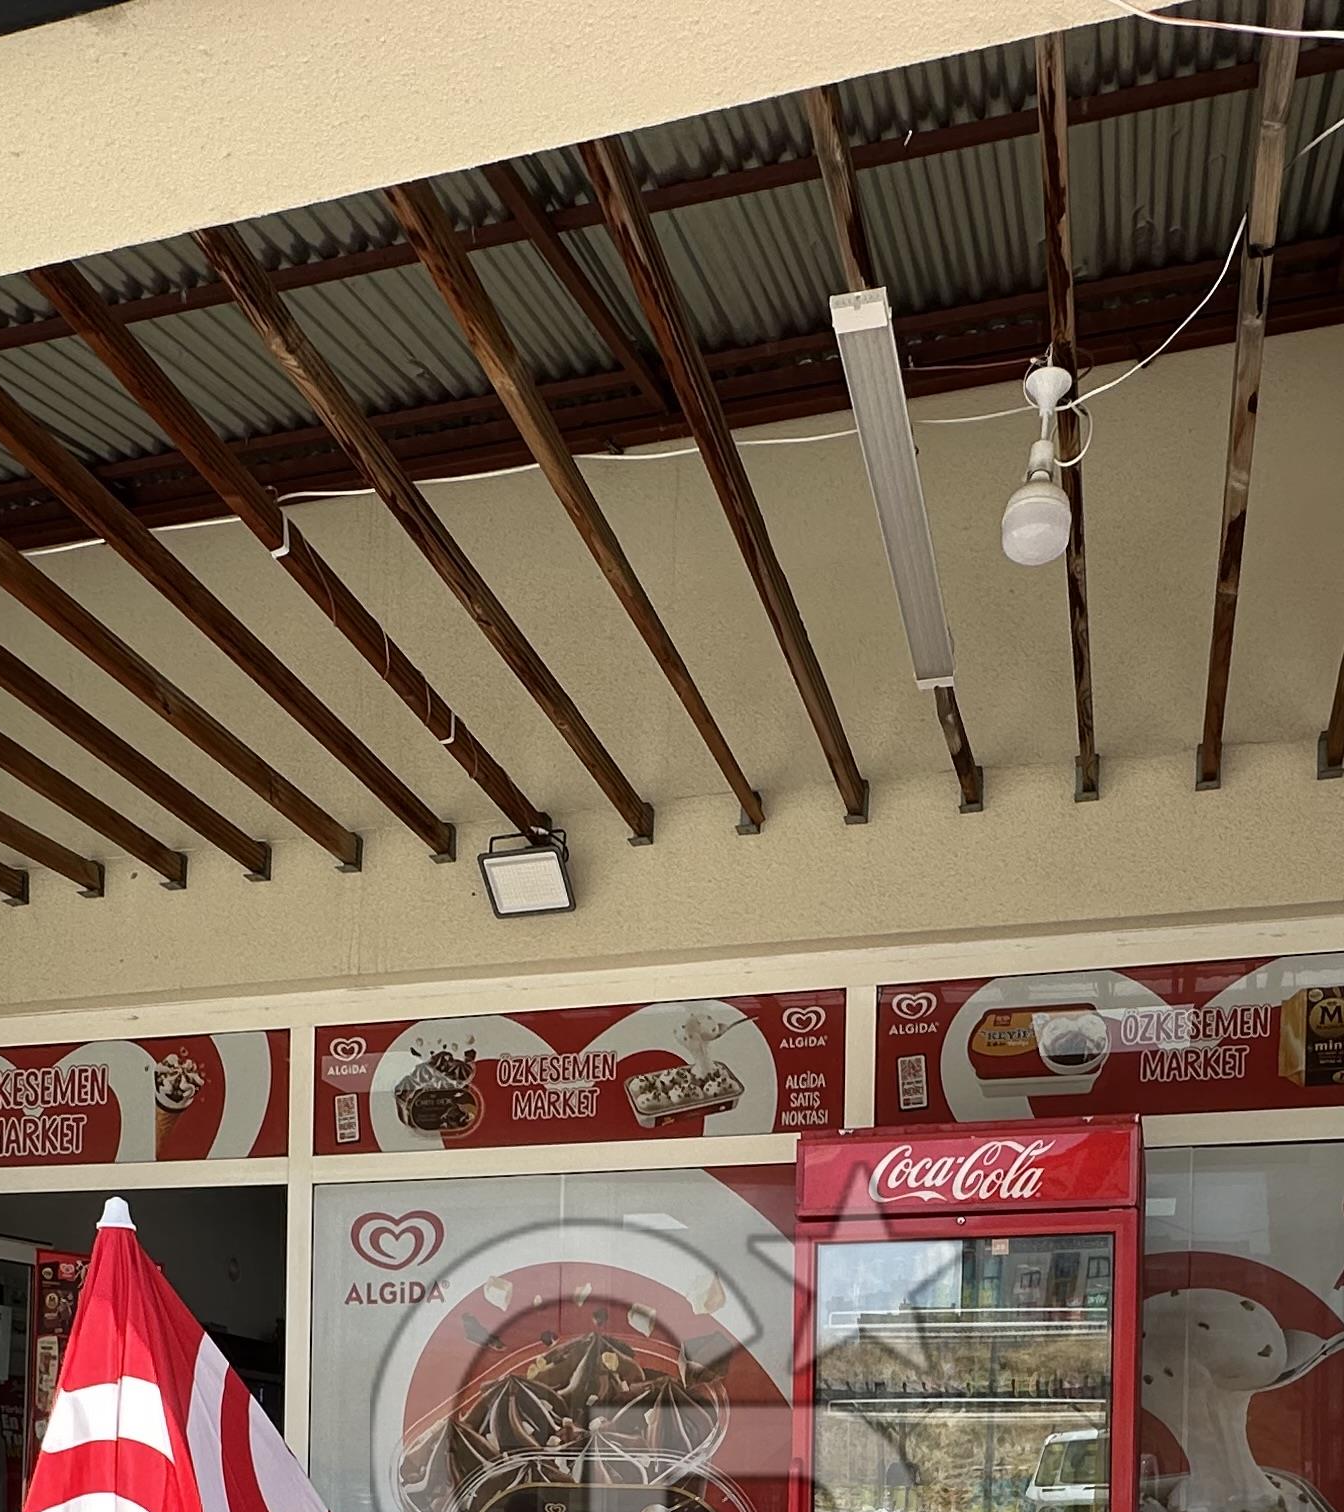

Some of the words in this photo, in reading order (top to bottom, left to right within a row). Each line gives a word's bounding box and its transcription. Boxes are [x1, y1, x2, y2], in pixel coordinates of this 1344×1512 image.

[1119, 1003, 1271, 1045] ÖZKESEMEN
[496, 1052, 617, 1086] ÖZKESEMEN
[1139, 1046, 1250, 1082] MARKET
[512, 1089, 598, 1119] MARKET
[790, 1092, 820, 1108] SATIŞ
[782, 1110, 828, 1125] NOKTASI
[869, 1139, 1056, 1203] Coca-Cola
